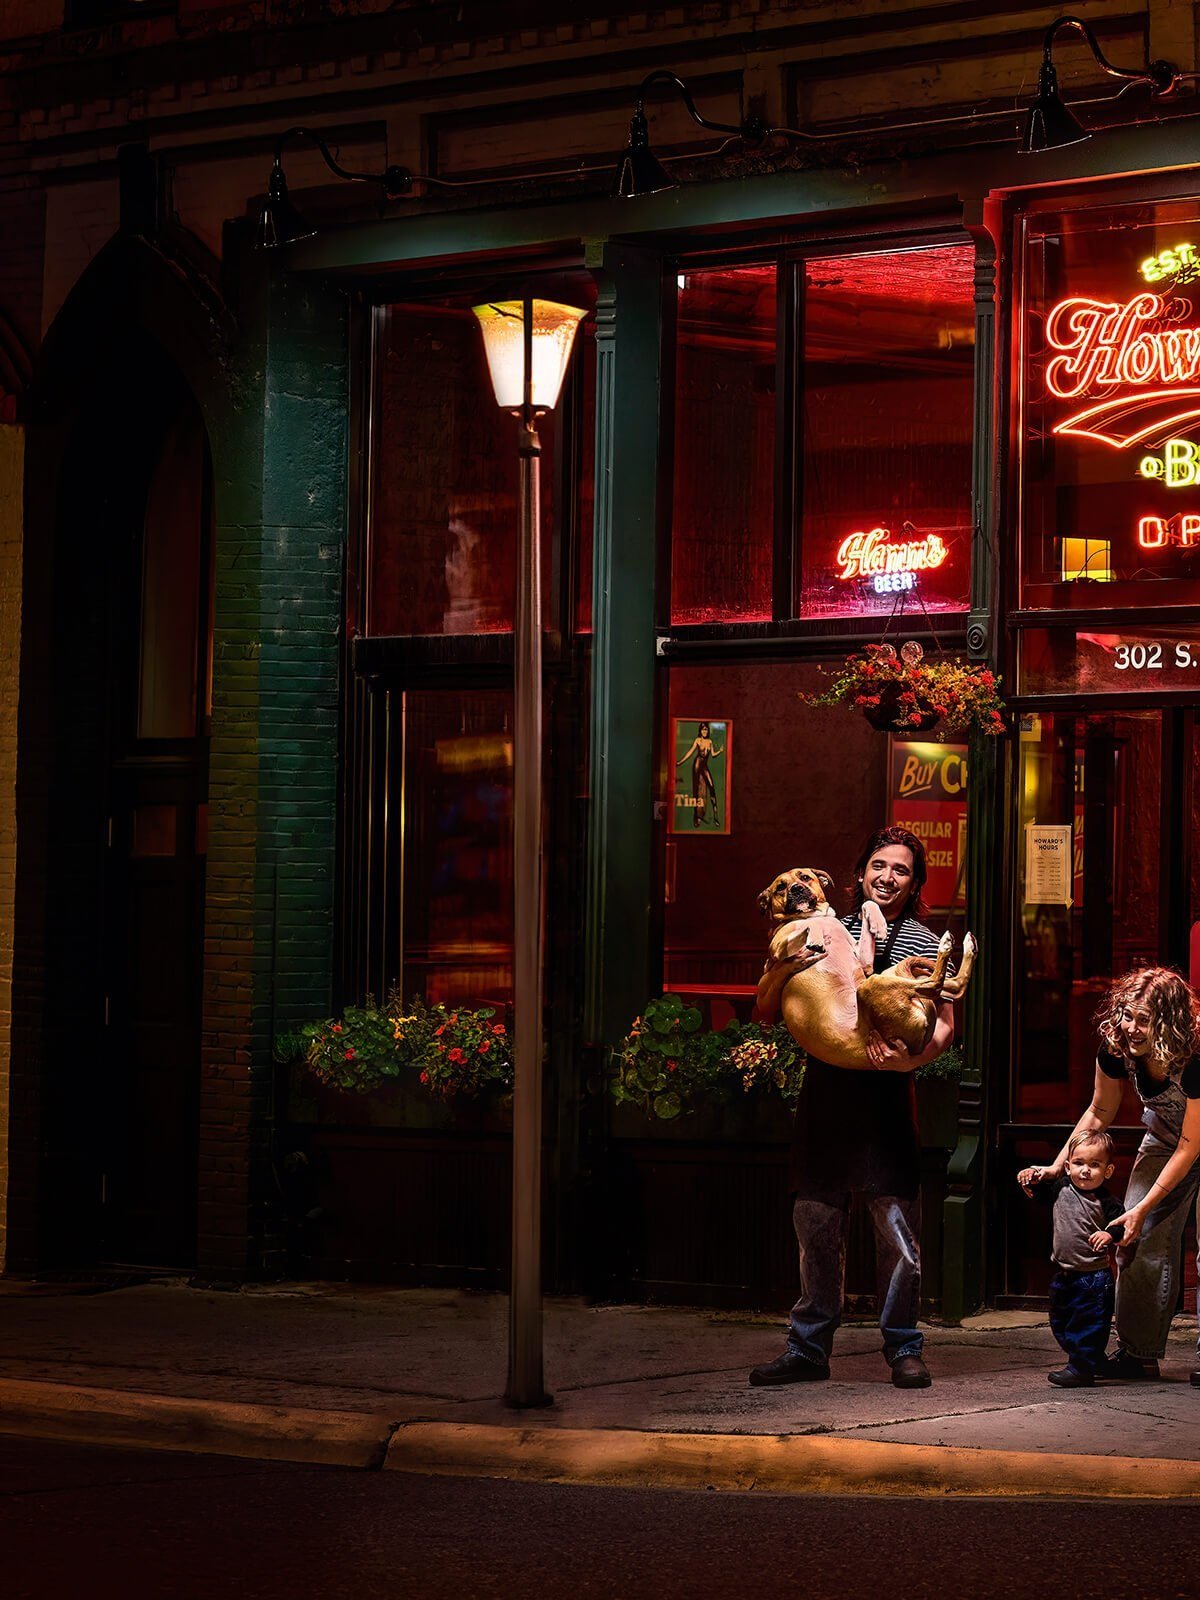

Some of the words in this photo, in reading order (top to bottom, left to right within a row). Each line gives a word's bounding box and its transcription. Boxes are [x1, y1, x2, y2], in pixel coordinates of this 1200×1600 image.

[837, 528, 947, 579] Hamm's
[874, 572, 914, 593] BEER
[1114, 643, 1163, 670] 302
[1174, 641, 1198, 668] S.
[675, 793, 705, 808] Tina
[896, 821, 952, 838] REGULAR
